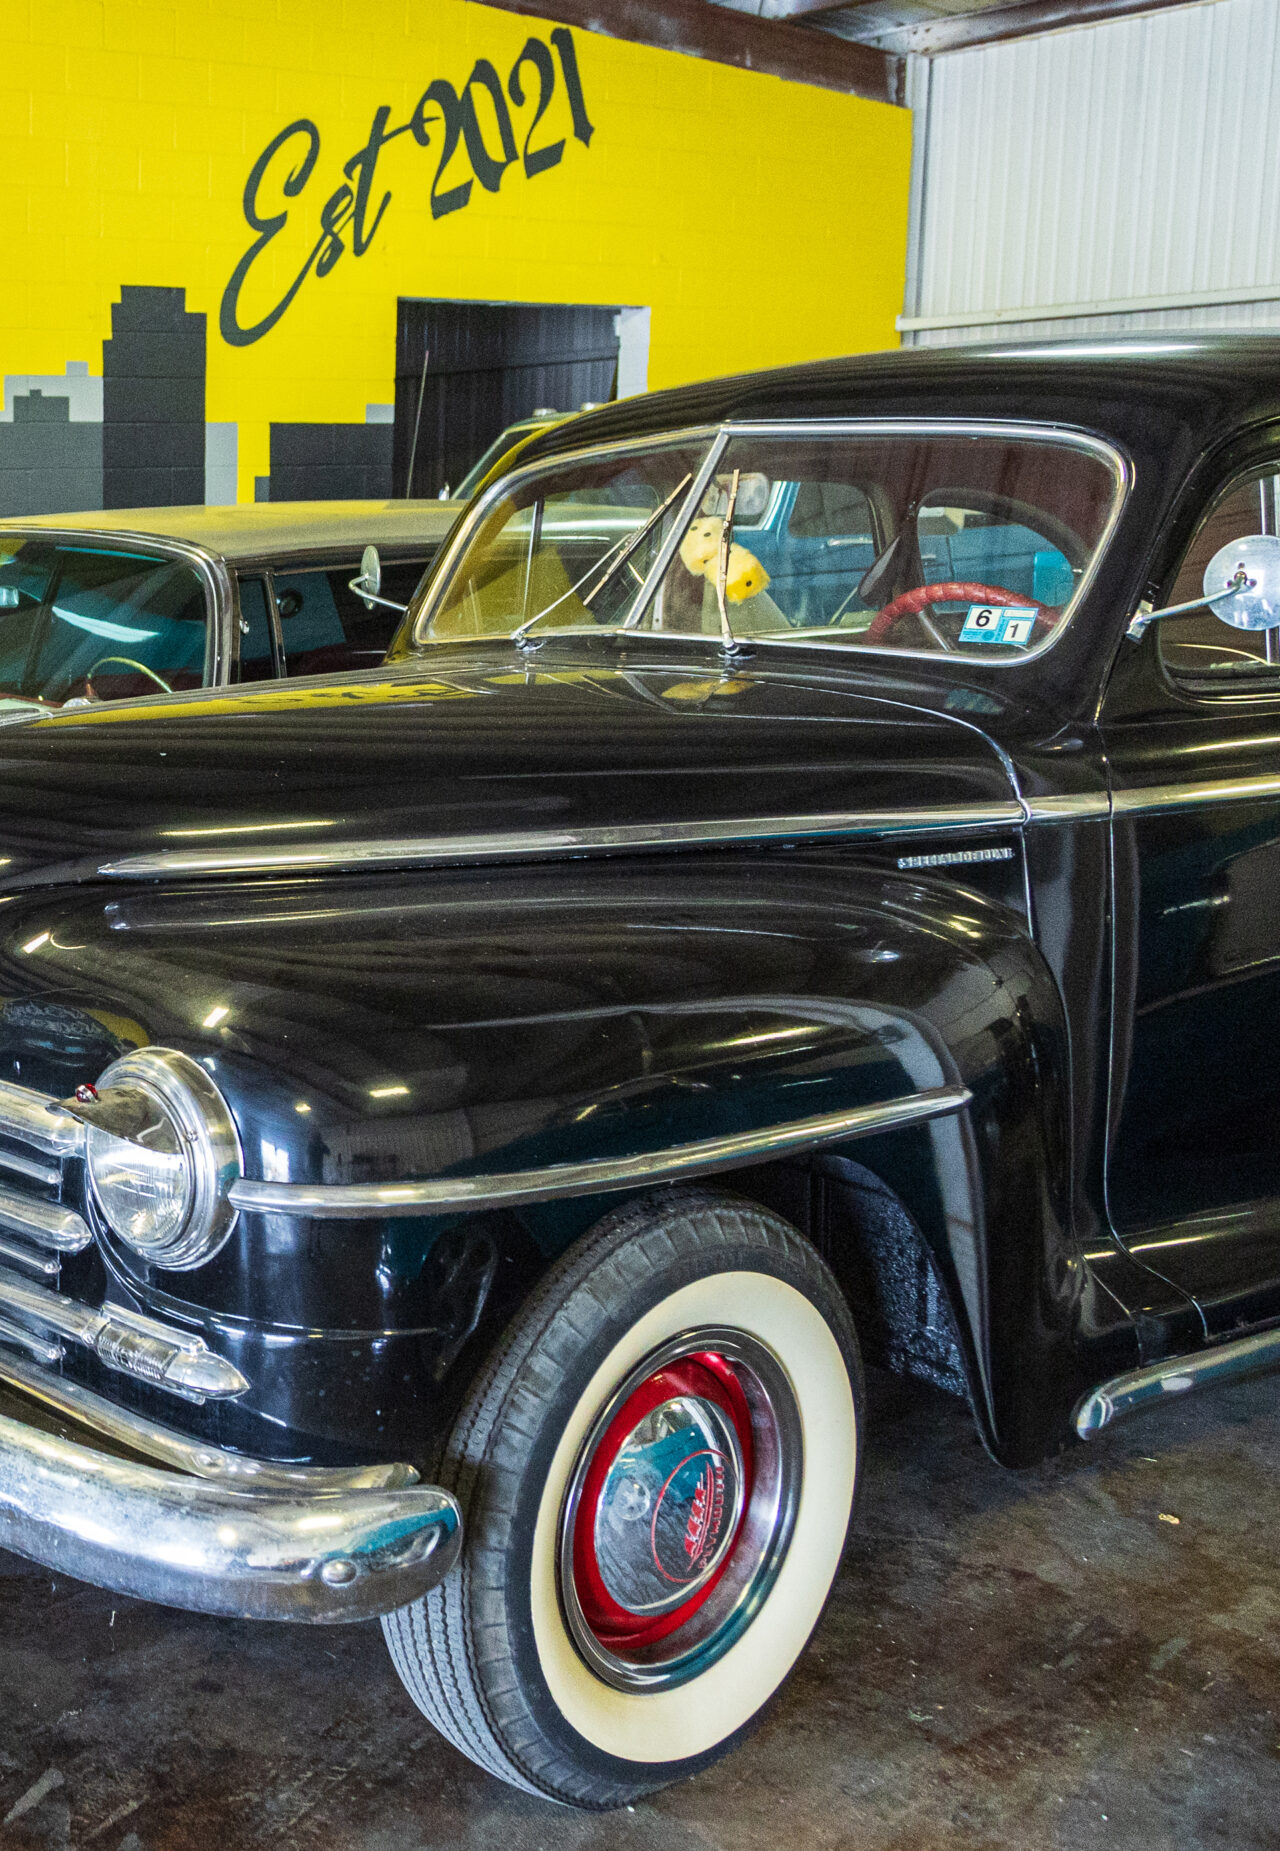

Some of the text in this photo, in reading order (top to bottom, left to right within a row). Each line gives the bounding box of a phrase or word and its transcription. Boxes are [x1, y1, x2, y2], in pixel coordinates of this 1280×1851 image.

[219, 27, 595, 347] Est 2021
[975, 609, 993, 628] 6
[1009, 623, 1020, 638] 1
[698, 1466, 725, 1569] PLYMOUTH
